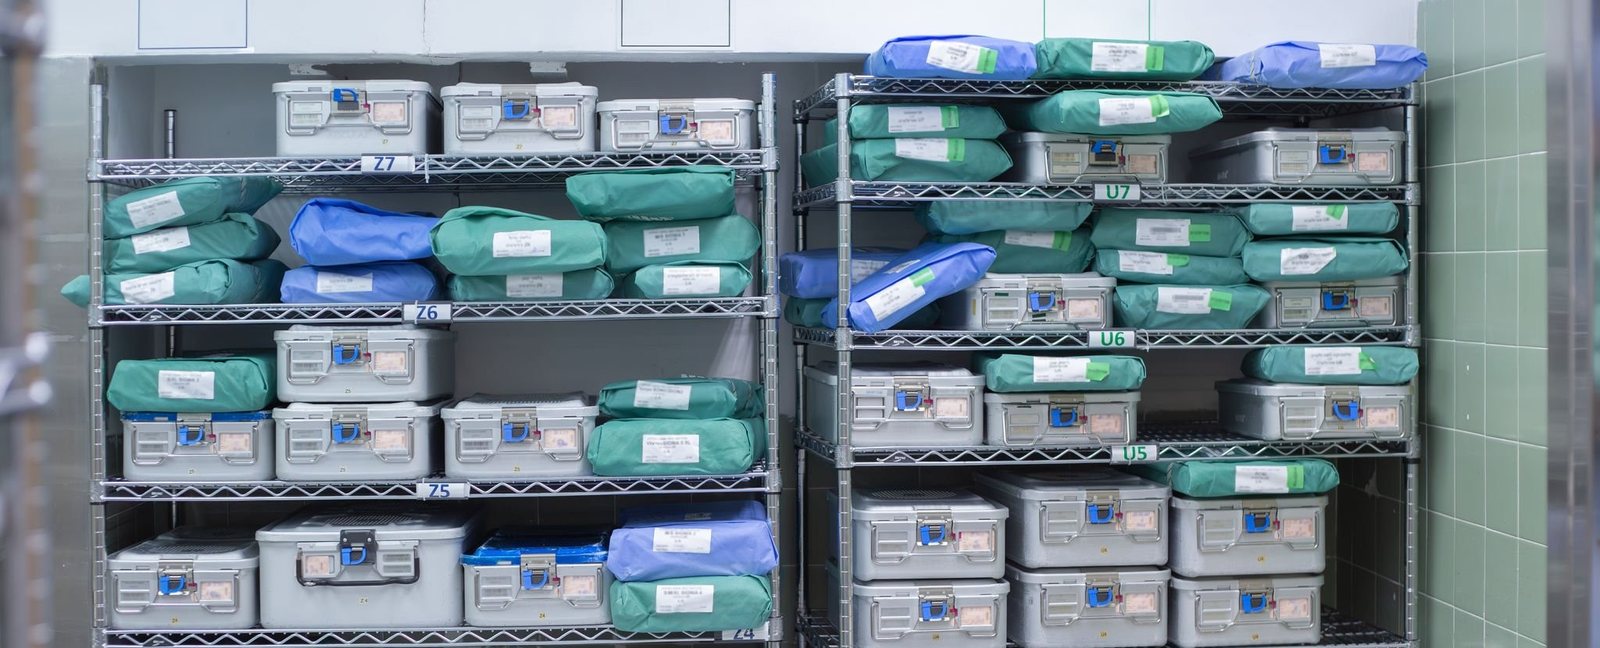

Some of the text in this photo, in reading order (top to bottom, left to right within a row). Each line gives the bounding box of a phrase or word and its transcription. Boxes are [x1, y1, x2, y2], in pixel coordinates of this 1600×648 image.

[374, 156, 395, 171] Z7
[1106, 185, 1130, 200] U7
[417, 305, 438, 320] Z6
[1101, 331, 1125, 346] U6
[1123, 446, 1147, 461] U5
[429, 484, 450, 498] Z5
